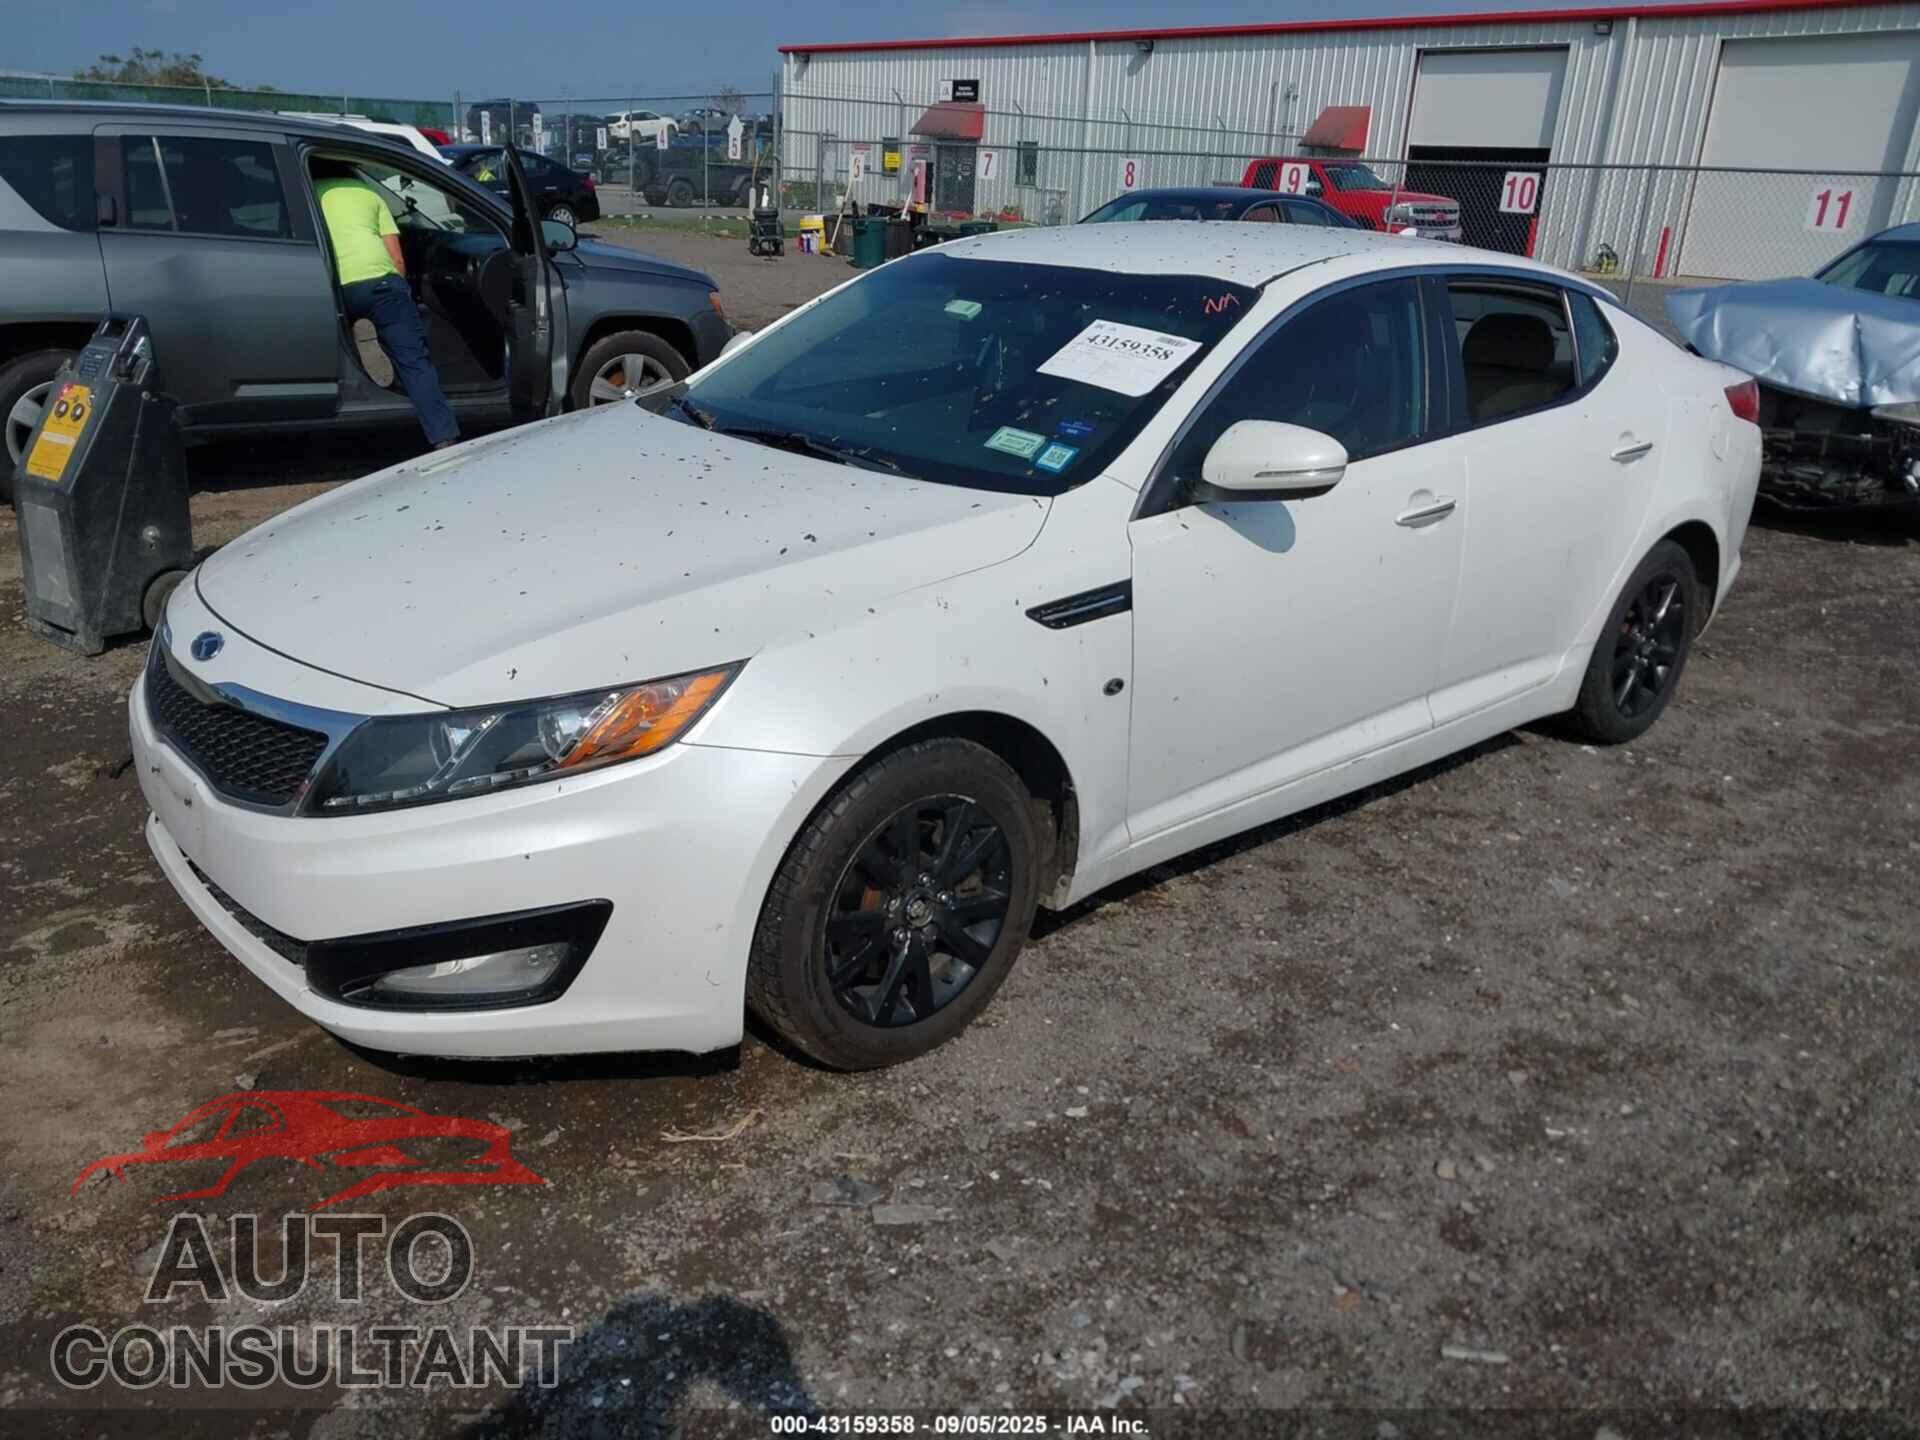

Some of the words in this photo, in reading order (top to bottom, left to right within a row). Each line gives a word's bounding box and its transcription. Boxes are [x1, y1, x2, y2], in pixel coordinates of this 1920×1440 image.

[732, 137, 739, 157] 5
[853, 155, 861, 178] 6
[983, 153, 993, 176] 7
[1125, 161, 1136, 188] 8
[1287, 166, 1301, 194] 9
[1505, 176, 1537, 210] 10
[1815, 189, 1853, 229] 11
[1087, 334, 1175, 361] 43159358
